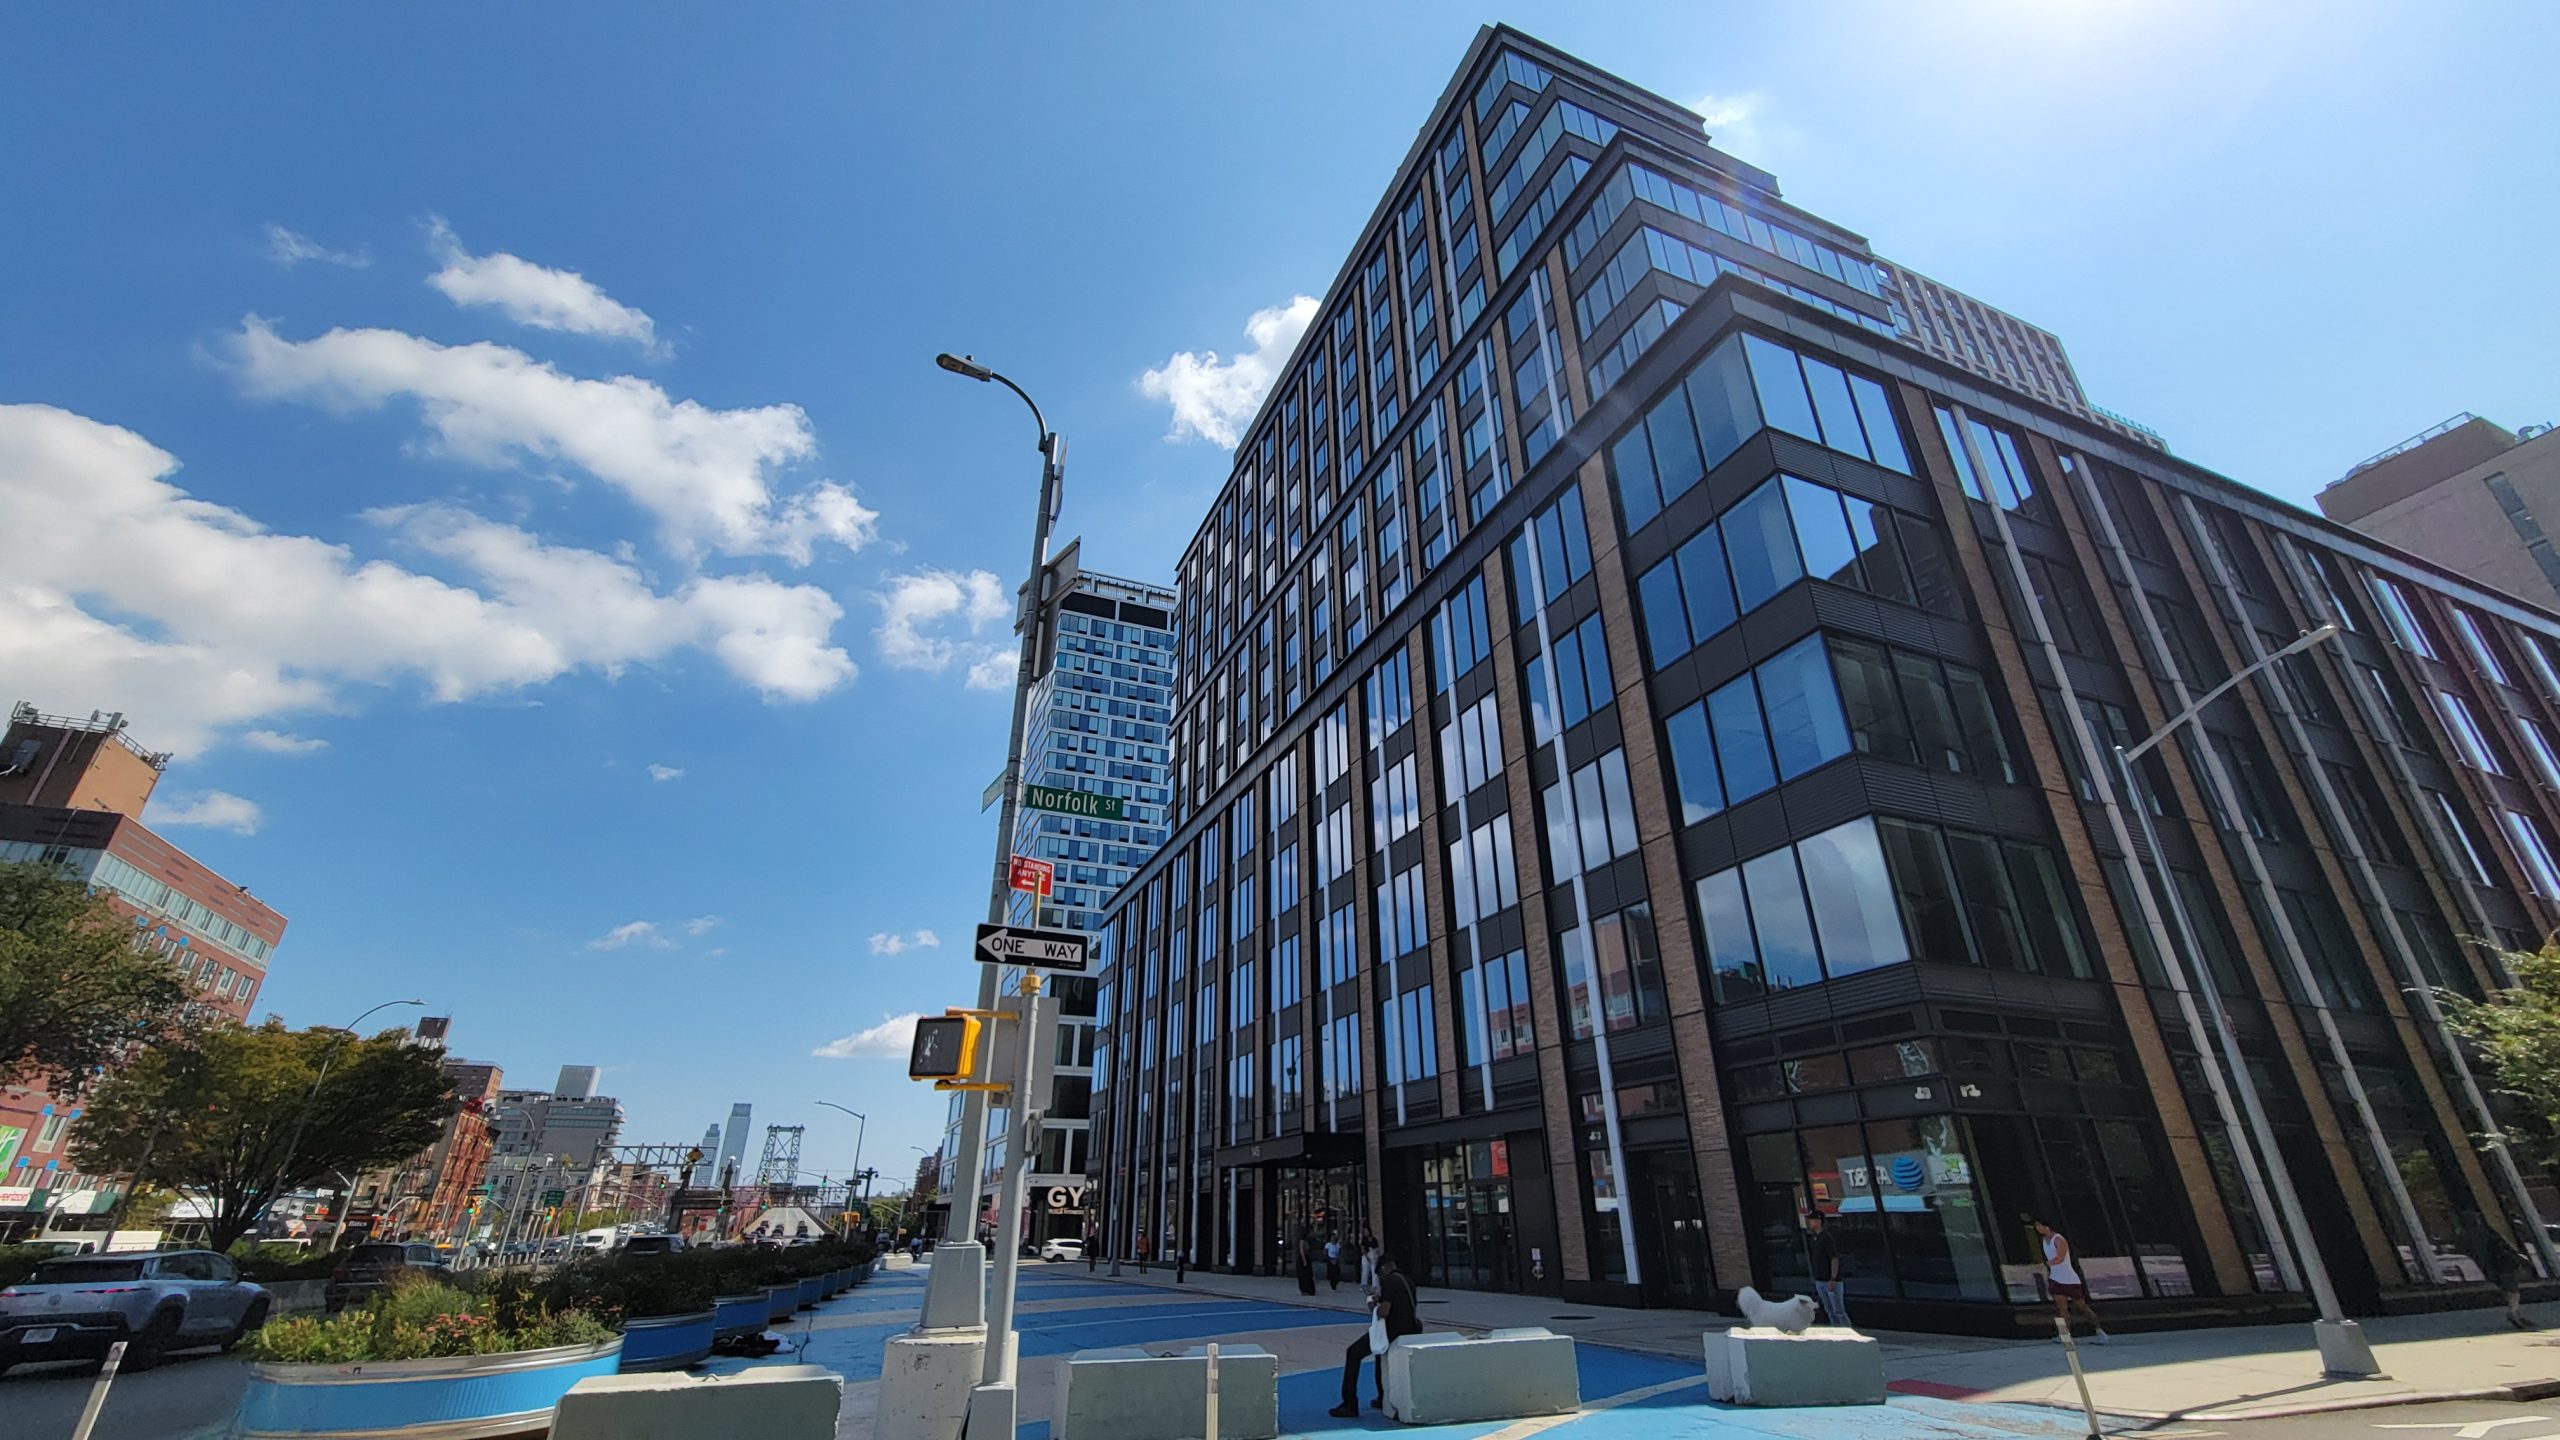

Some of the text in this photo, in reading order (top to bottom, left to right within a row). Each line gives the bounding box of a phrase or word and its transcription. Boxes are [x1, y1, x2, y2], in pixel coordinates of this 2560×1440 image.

[1032, 788, 1116, 815] Norfolk St
[1013, 858, 1051, 873] NO STANDING
[1017, 869, 1046, 881] ANYTE
[991, 938, 1078, 959] ONE WAY
